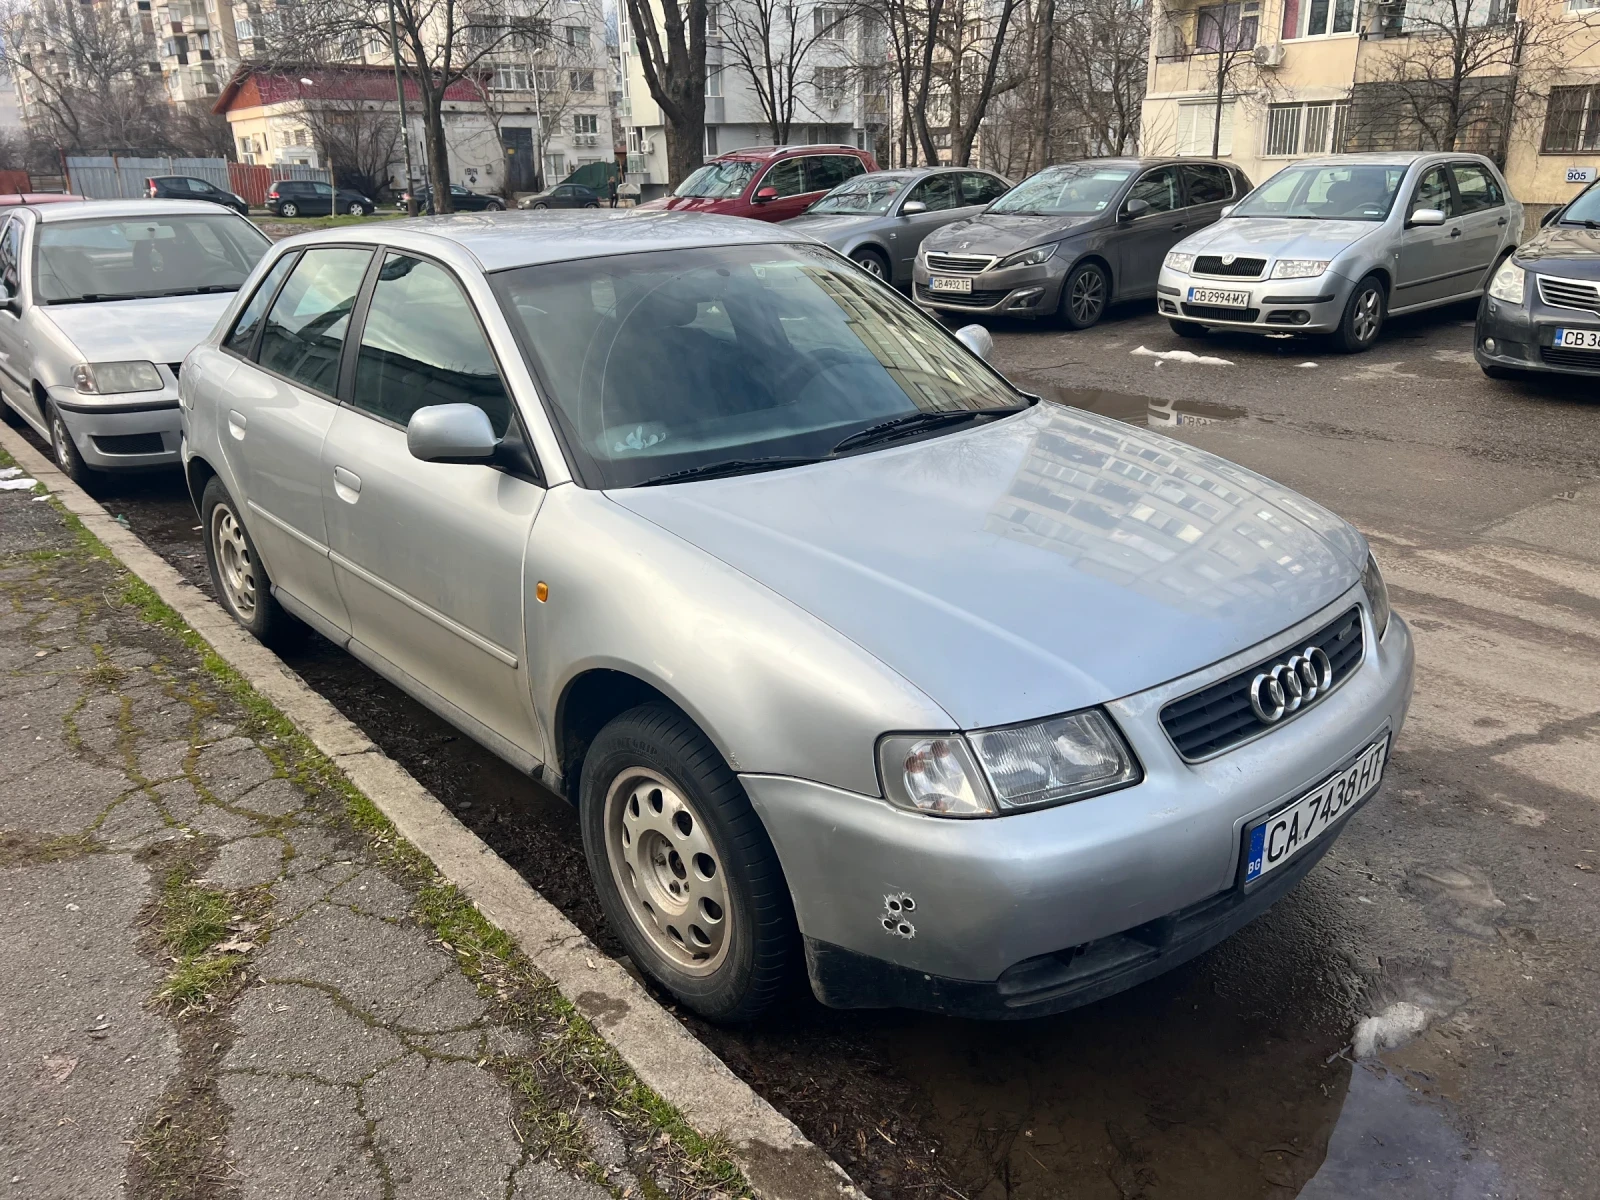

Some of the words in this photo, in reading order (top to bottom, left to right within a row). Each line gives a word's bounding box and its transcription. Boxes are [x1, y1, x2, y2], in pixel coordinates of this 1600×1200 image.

[1567, 171, 1587, 181] 905
[934, 279, 943, 289] CB
[944, 279, 961, 290] 4932
[961, 280, 970, 290] TE
[1194, 290, 1206, 302] CB
[1207, 291, 1231, 304] 2994
[1231, 292, 1247, 305] MX
[1564, 331, 1585, 346] CB
[1587, 333, 1600, 348] 3
[1267, 810, 1299, 863] CA
[1304, 768, 1358, 839] 7438
[1357, 743, 1385, 796] HT
[1247, 858, 1261, 875] BG
